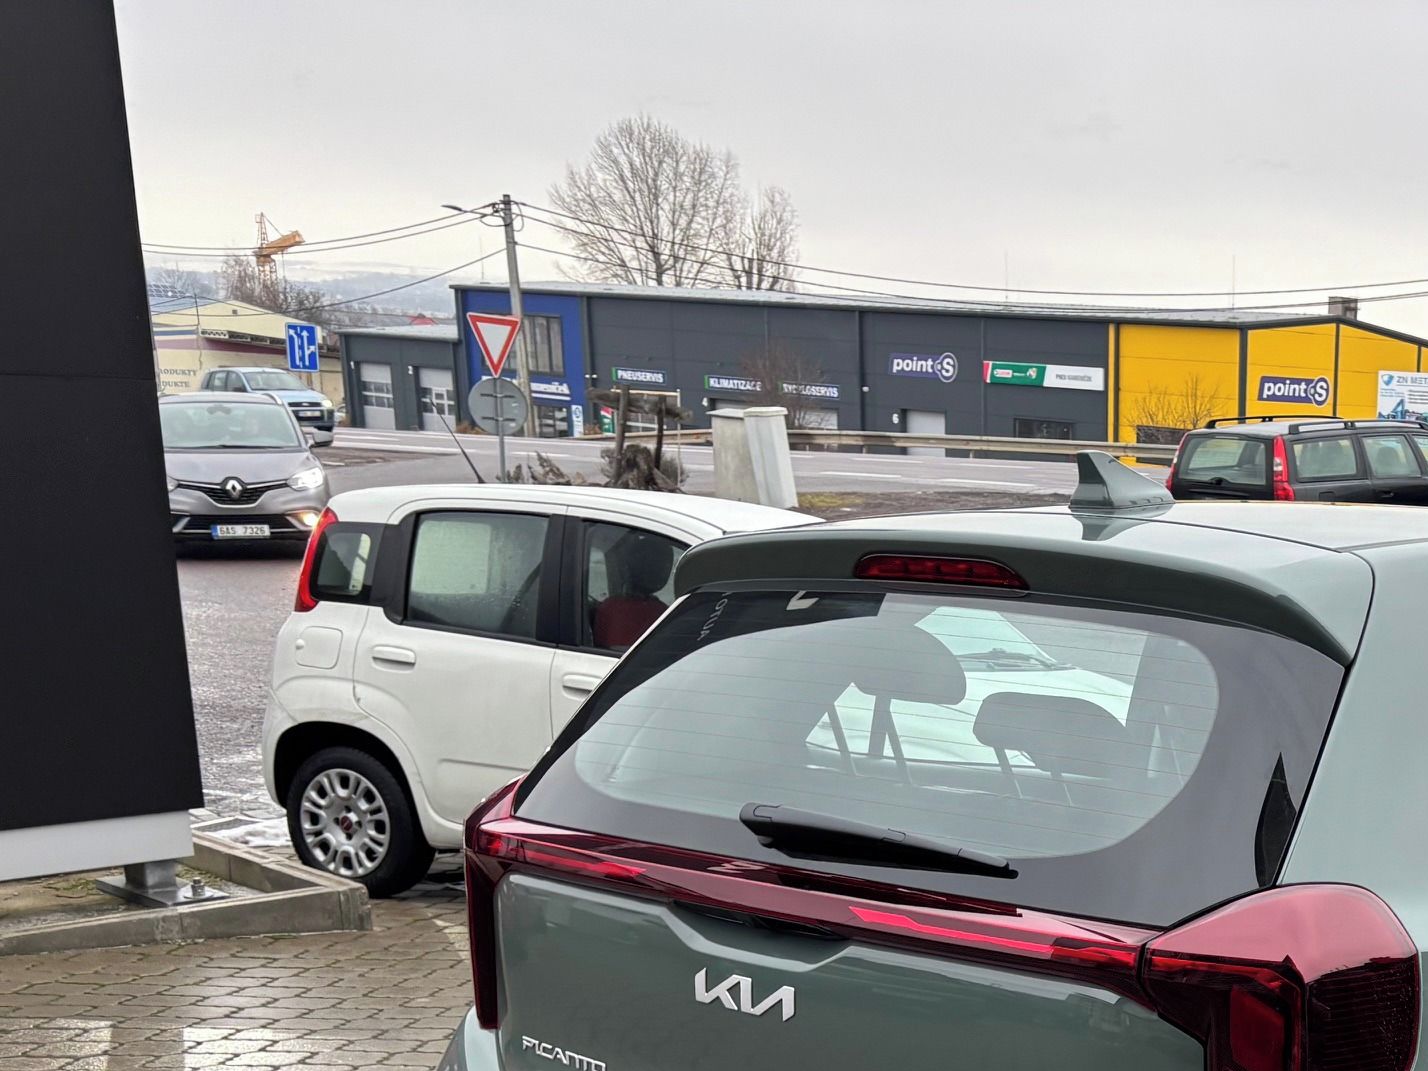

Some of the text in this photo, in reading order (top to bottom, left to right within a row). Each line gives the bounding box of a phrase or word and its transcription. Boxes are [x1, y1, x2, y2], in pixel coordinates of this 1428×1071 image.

[1262, 379, 1307, 399] point
[1396, 375, 1408, 384] ZN
[694, 967, 795, 1023] KIA
